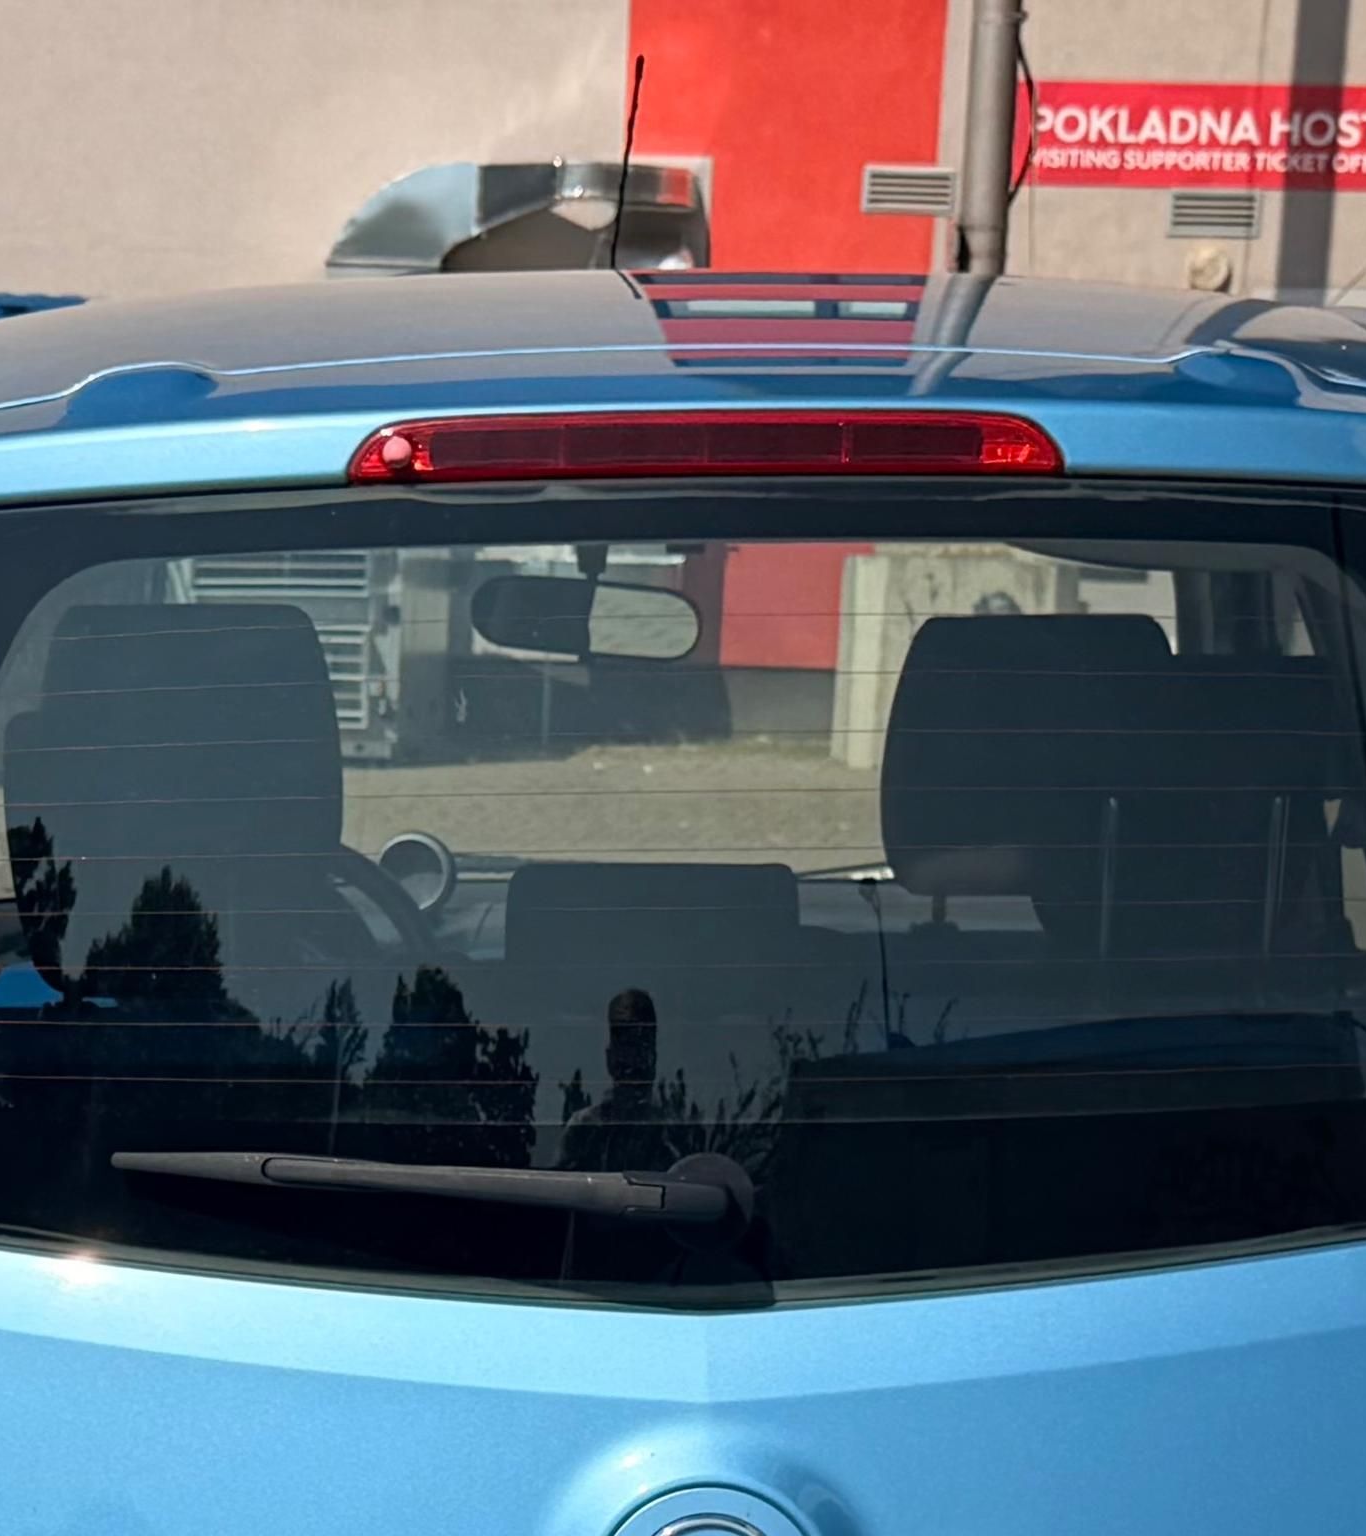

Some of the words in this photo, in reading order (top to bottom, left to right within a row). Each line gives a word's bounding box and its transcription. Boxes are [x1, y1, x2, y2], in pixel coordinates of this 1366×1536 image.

[1035, 106, 1261, 146] POKLADNA
[1124, 149, 1250, 173] SUPPORTER
[1255, 152, 1329, 174] TICKET
